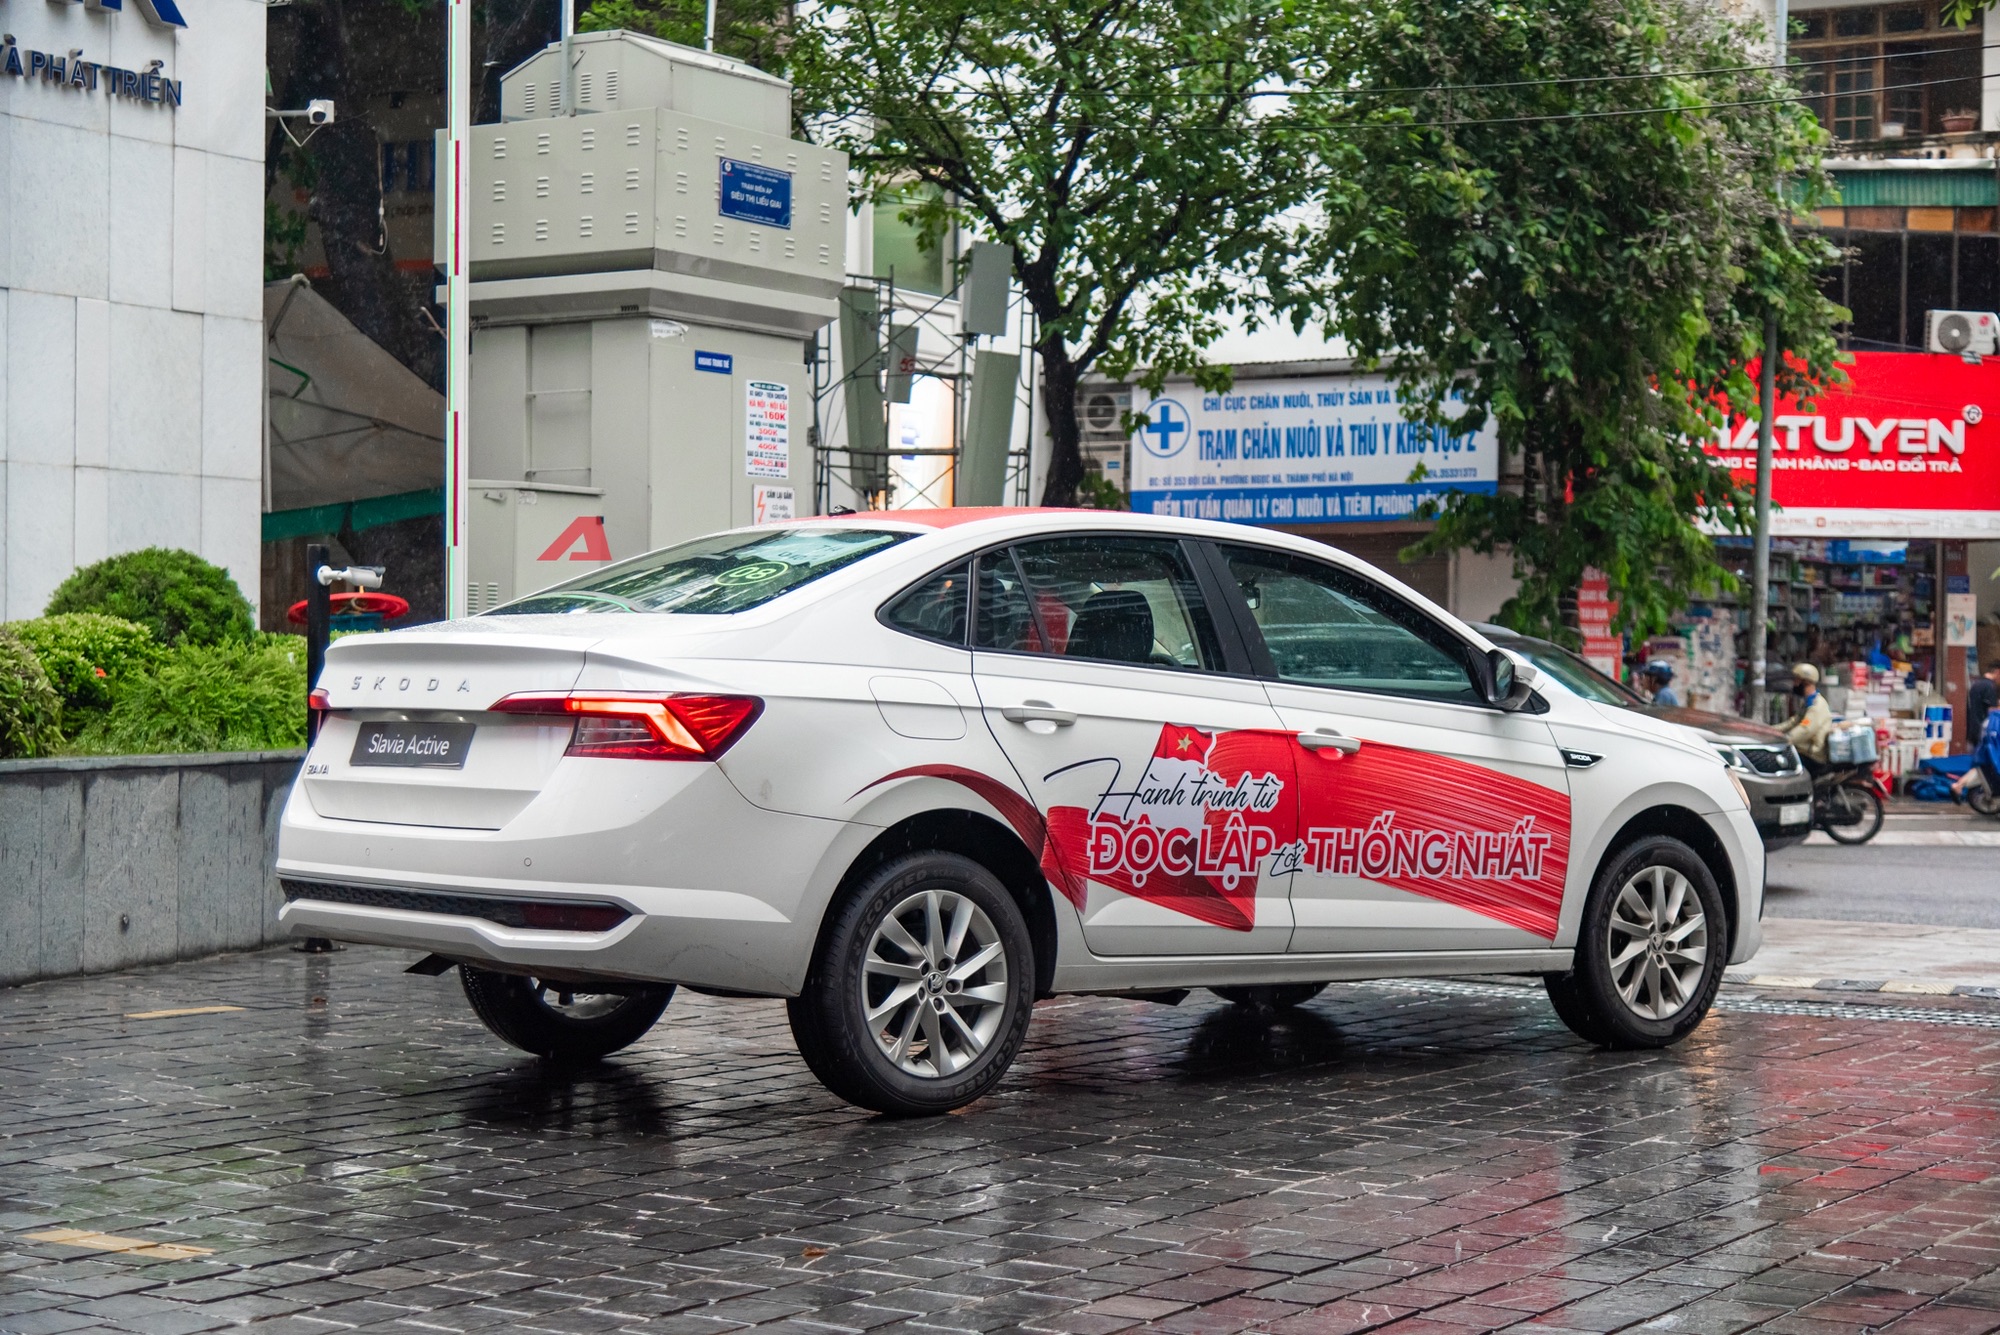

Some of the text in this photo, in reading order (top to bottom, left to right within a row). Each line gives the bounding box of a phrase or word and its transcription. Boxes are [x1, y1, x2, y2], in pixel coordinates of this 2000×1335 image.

[0, 34, 182, 106] À PHÁT TRIỂN
[1224, 396, 1247, 414] CỤC
[1283, 390, 1314, 409] NUÔI,
[1317, 388, 1345, 407] THỦY
[1349, 386, 1373, 405] SẢN
[1376, 386, 1391, 404] VÀ
[764, 411, 786, 421] 160K
[1198, 428, 1238, 468] TRẠM
[1241, 420, 1282, 460] CHĂN
[1286, 418, 1321, 459] NUÔI
[1325, 417, 1345, 457] VÀ
[1349, 416, 1378, 456] THÚ
[1382, 422, 1392, 455] Y
[1466, 428, 1477, 452] 2
[1744, 456, 1798, 470] CNH
[1897, 455, 1927, 473] ĐỔI
[1929, 456, 1963, 473] TRẢ
[1340, 471, 1354, 483] NỘI
[1199, 492, 1220, 518] VẤN
[1223, 492, 1254, 520] QUẢN
[1255, 494, 1269, 519] LÝ
[1271, 493, 1293, 518] CHÓ
[1294, 493, 1323, 518] NUÔI
[1326, 492, 1342, 517] VÀ
[1344, 491, 1371, 517] TIÊM
[1374, 490, 1414, 516] PHÒNG
[729, 567, 777, 579] 08
[351, 676, 470, 693] SKODA
[368, 733, 450, 756] Slavia Active
[1043, 755, 1281, 821] Hành trình từ
[1089, 811, 1552, 890] ĐỘC LẬP tới THỐNG NHẤT
